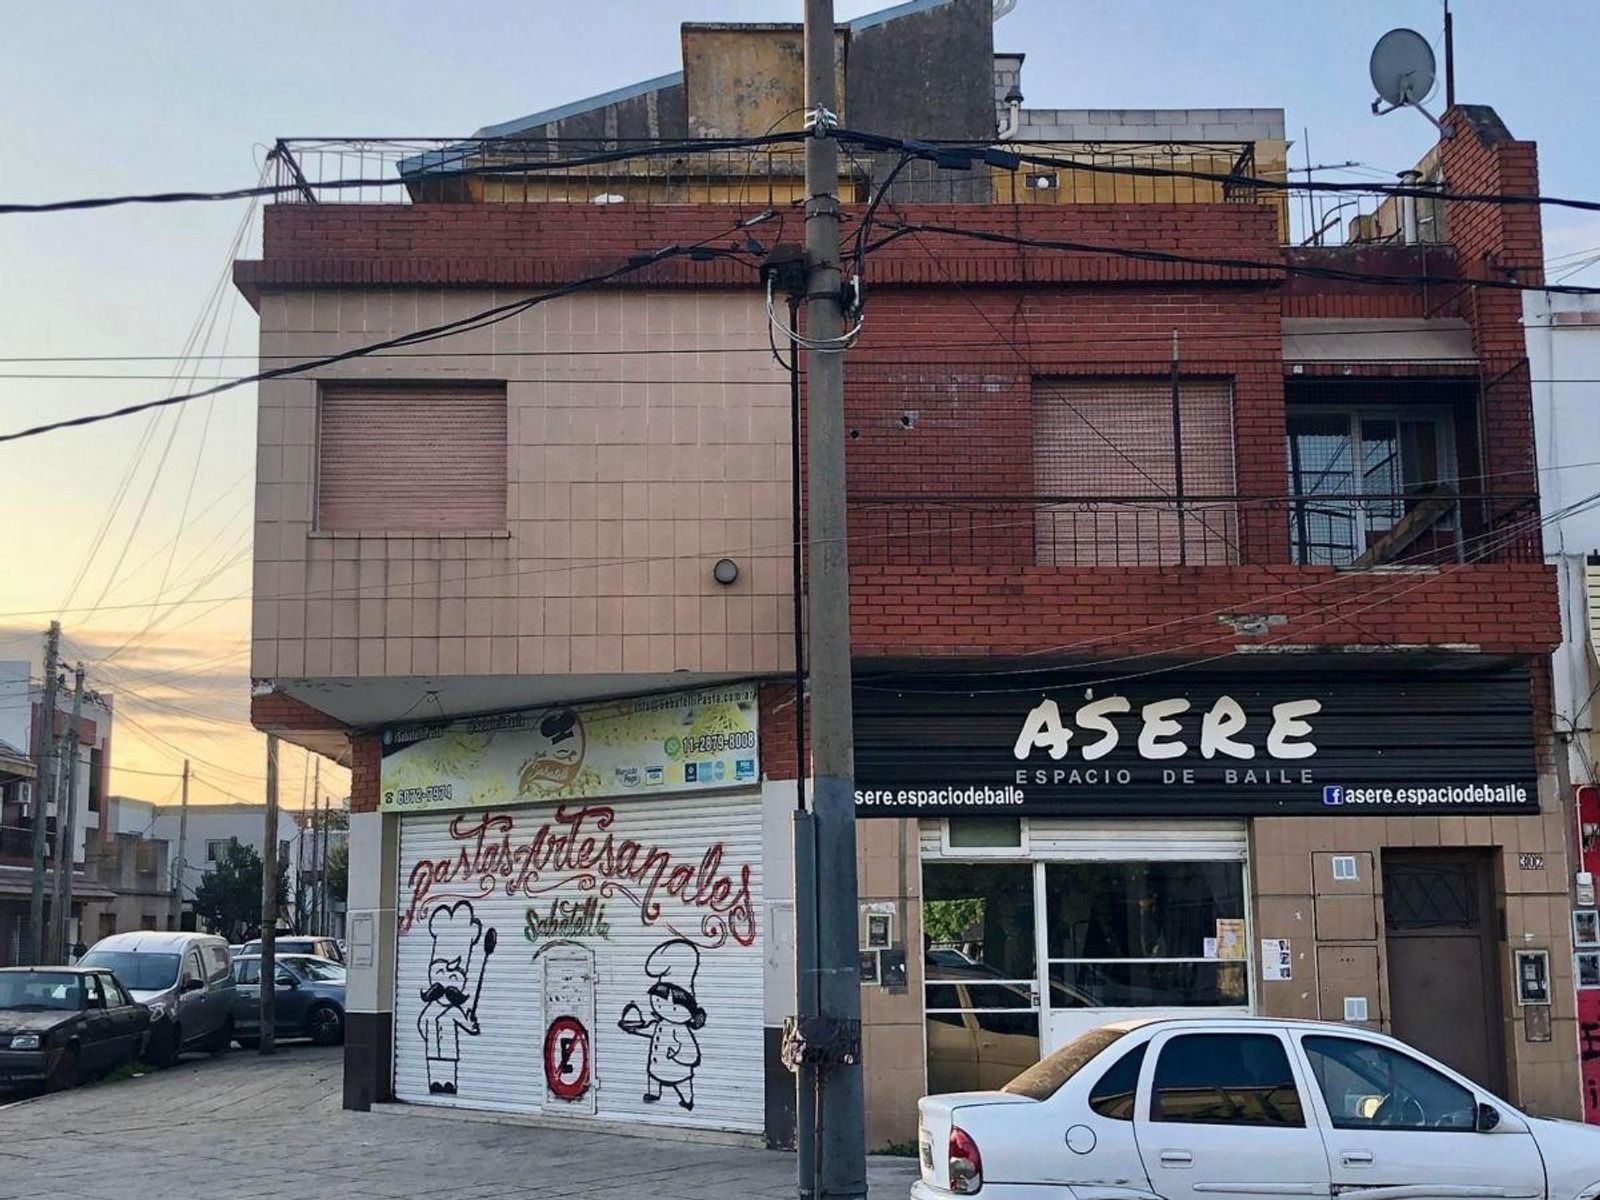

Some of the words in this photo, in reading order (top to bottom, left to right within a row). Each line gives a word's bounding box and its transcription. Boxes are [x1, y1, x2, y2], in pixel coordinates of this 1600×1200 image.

[1013, 695, 1322, 761] ASERE
[1016, 768, 1131, 785] ESPACIO
[1164, 768, 1195, 785] DE
[1226, 768, 1314, 785] BAILE
[853, 786, 1024, 808] sere.espaciodebaile
[1345, 785, 1527, 806] asere.espaciodebaile
